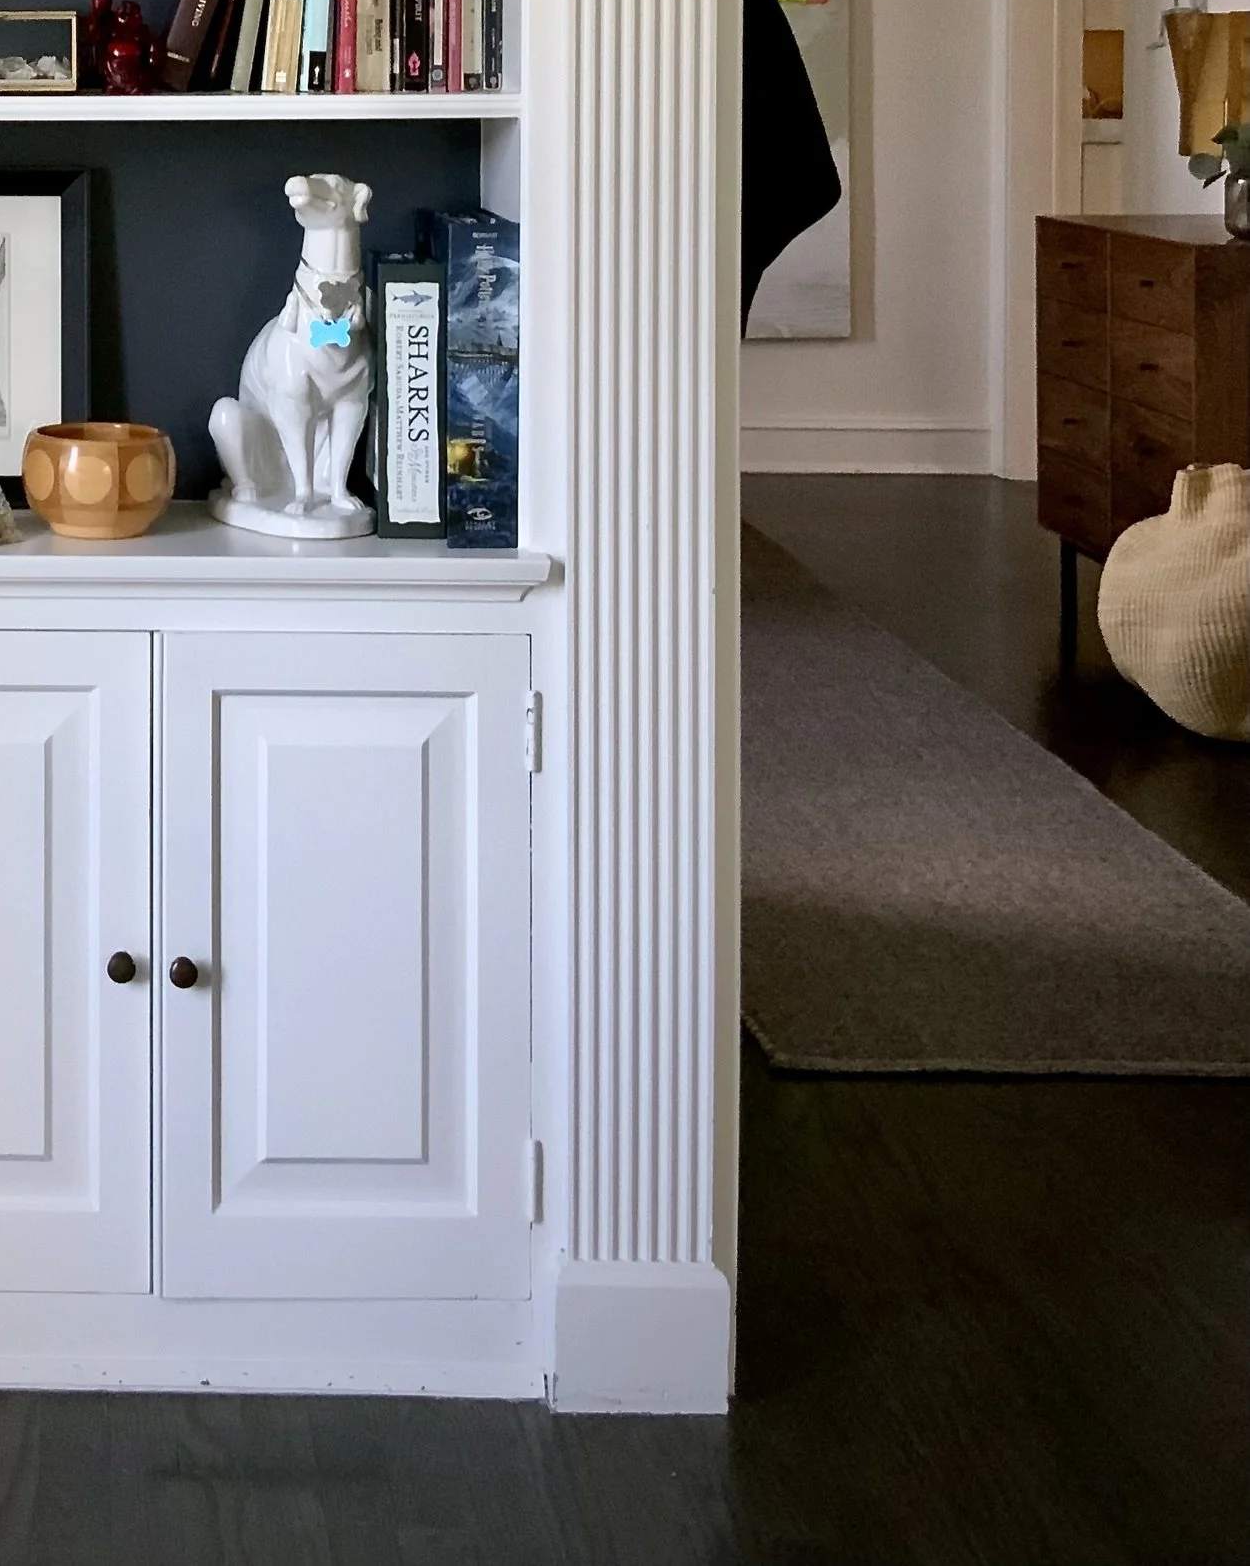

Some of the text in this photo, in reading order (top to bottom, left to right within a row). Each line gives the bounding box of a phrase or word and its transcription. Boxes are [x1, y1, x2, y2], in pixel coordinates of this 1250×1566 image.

[395, 325, 404, 361] ROBERT
[407, 325, 429, 443] SHARKS
[395, 405, 404, 451] MATTHEW
[395, 453, 404, 501] REINHART
